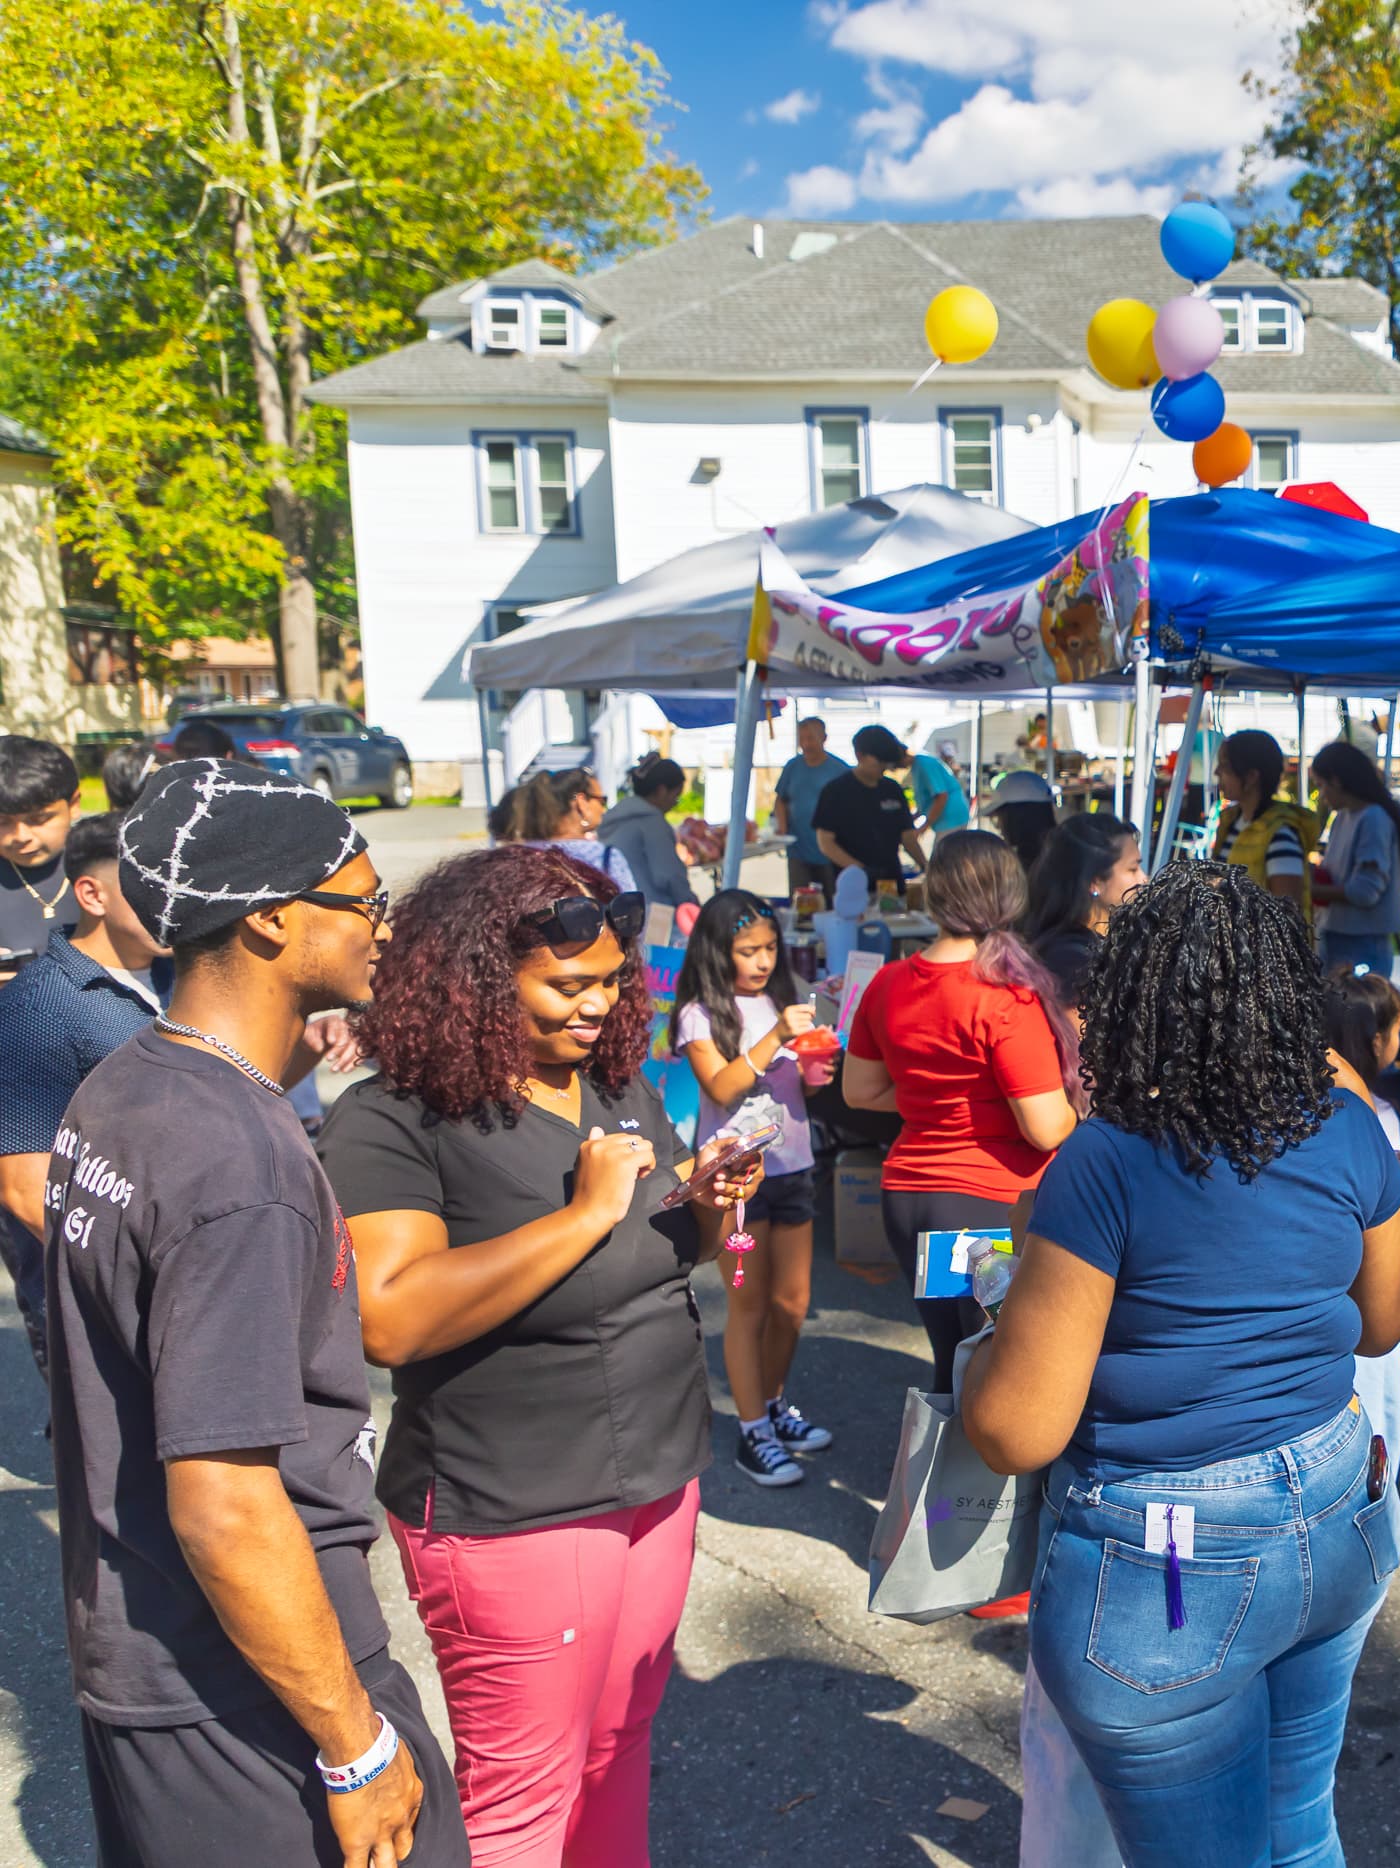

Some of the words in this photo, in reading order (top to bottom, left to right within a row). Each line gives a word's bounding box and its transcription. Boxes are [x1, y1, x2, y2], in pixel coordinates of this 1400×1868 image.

[64, 1206, 96, 1249] St
[956, 1496, 974, 1508] SY
[350, 1779, 363, 1790] DJ
